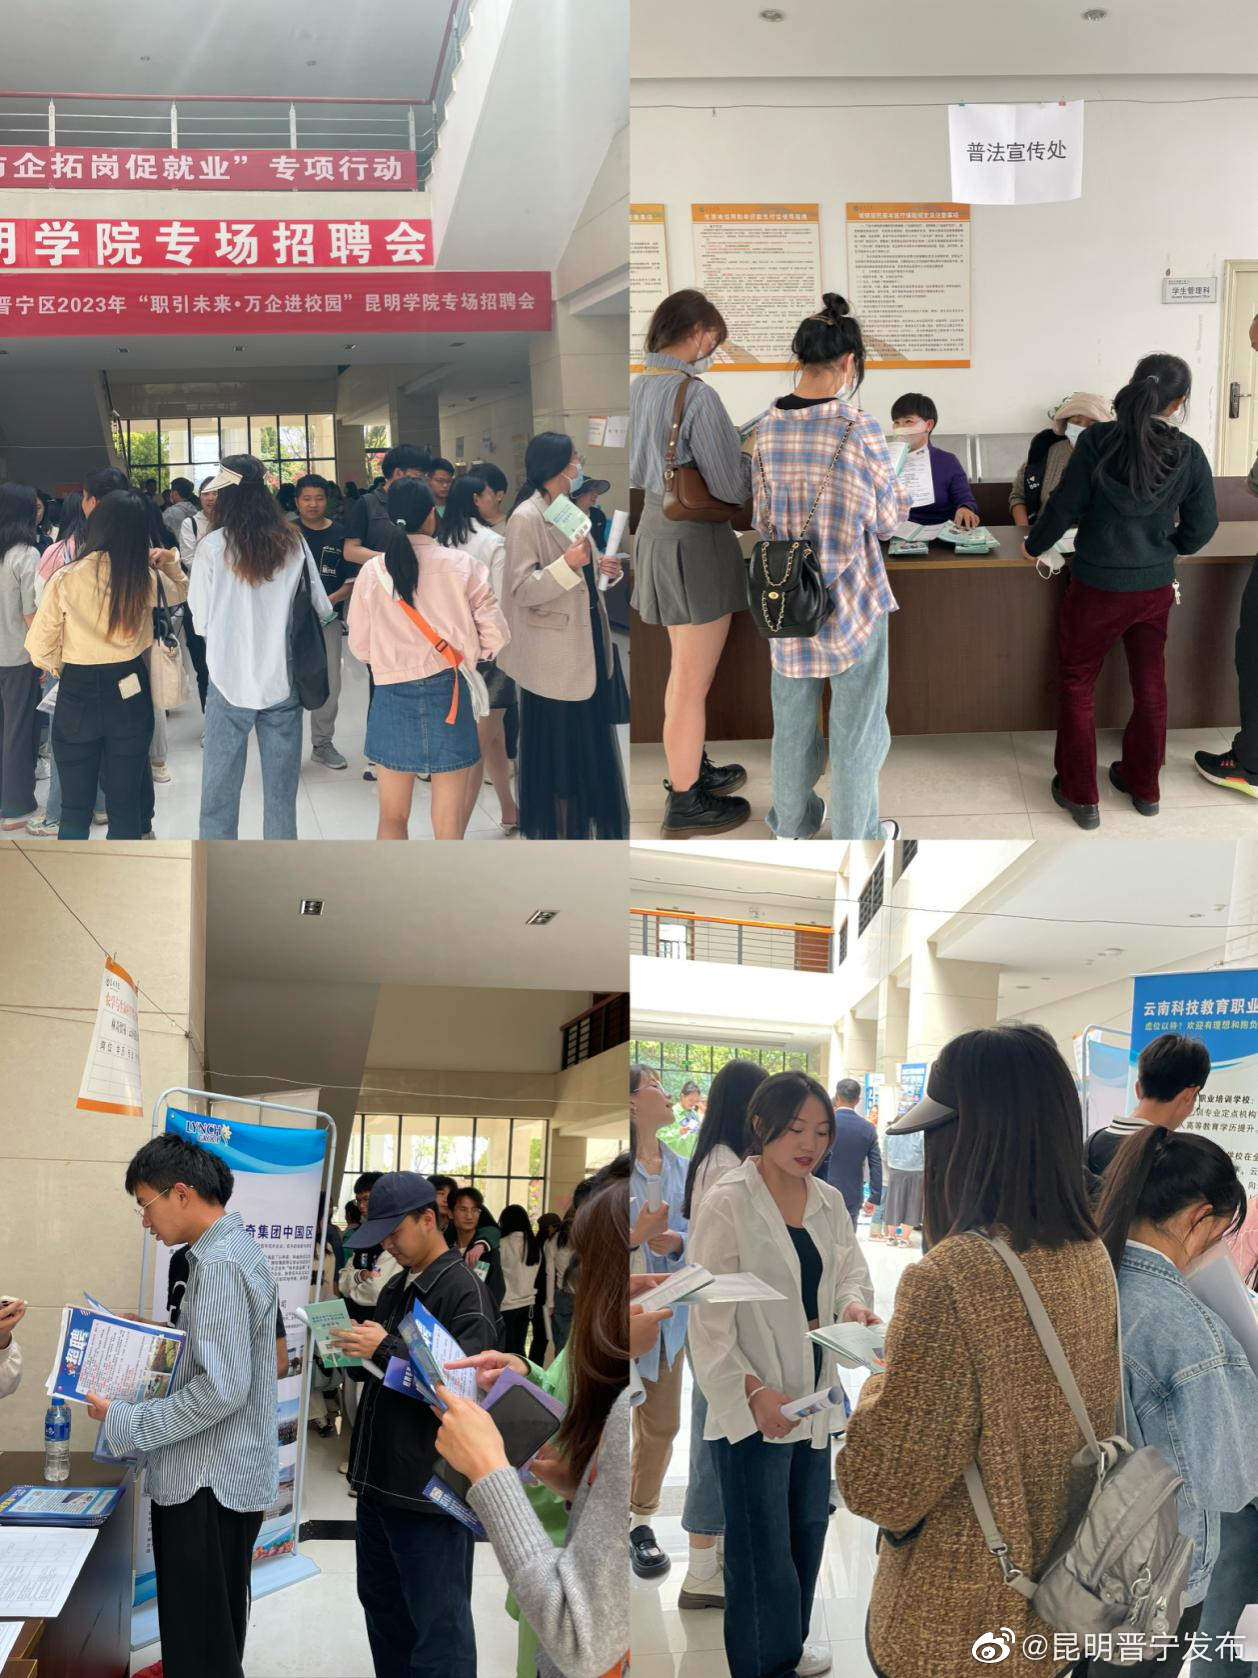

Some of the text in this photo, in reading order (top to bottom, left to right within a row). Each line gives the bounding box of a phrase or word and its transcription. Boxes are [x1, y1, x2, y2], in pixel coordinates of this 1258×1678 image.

[966, 139, 1067, 162] 普法宣传处
[1143, 998, 1258, 1017] 云南科技教育职业
[185, 1120, 222, 1136] LYNCH
[245, 1223, 314, 1240] 奇集团中国区
